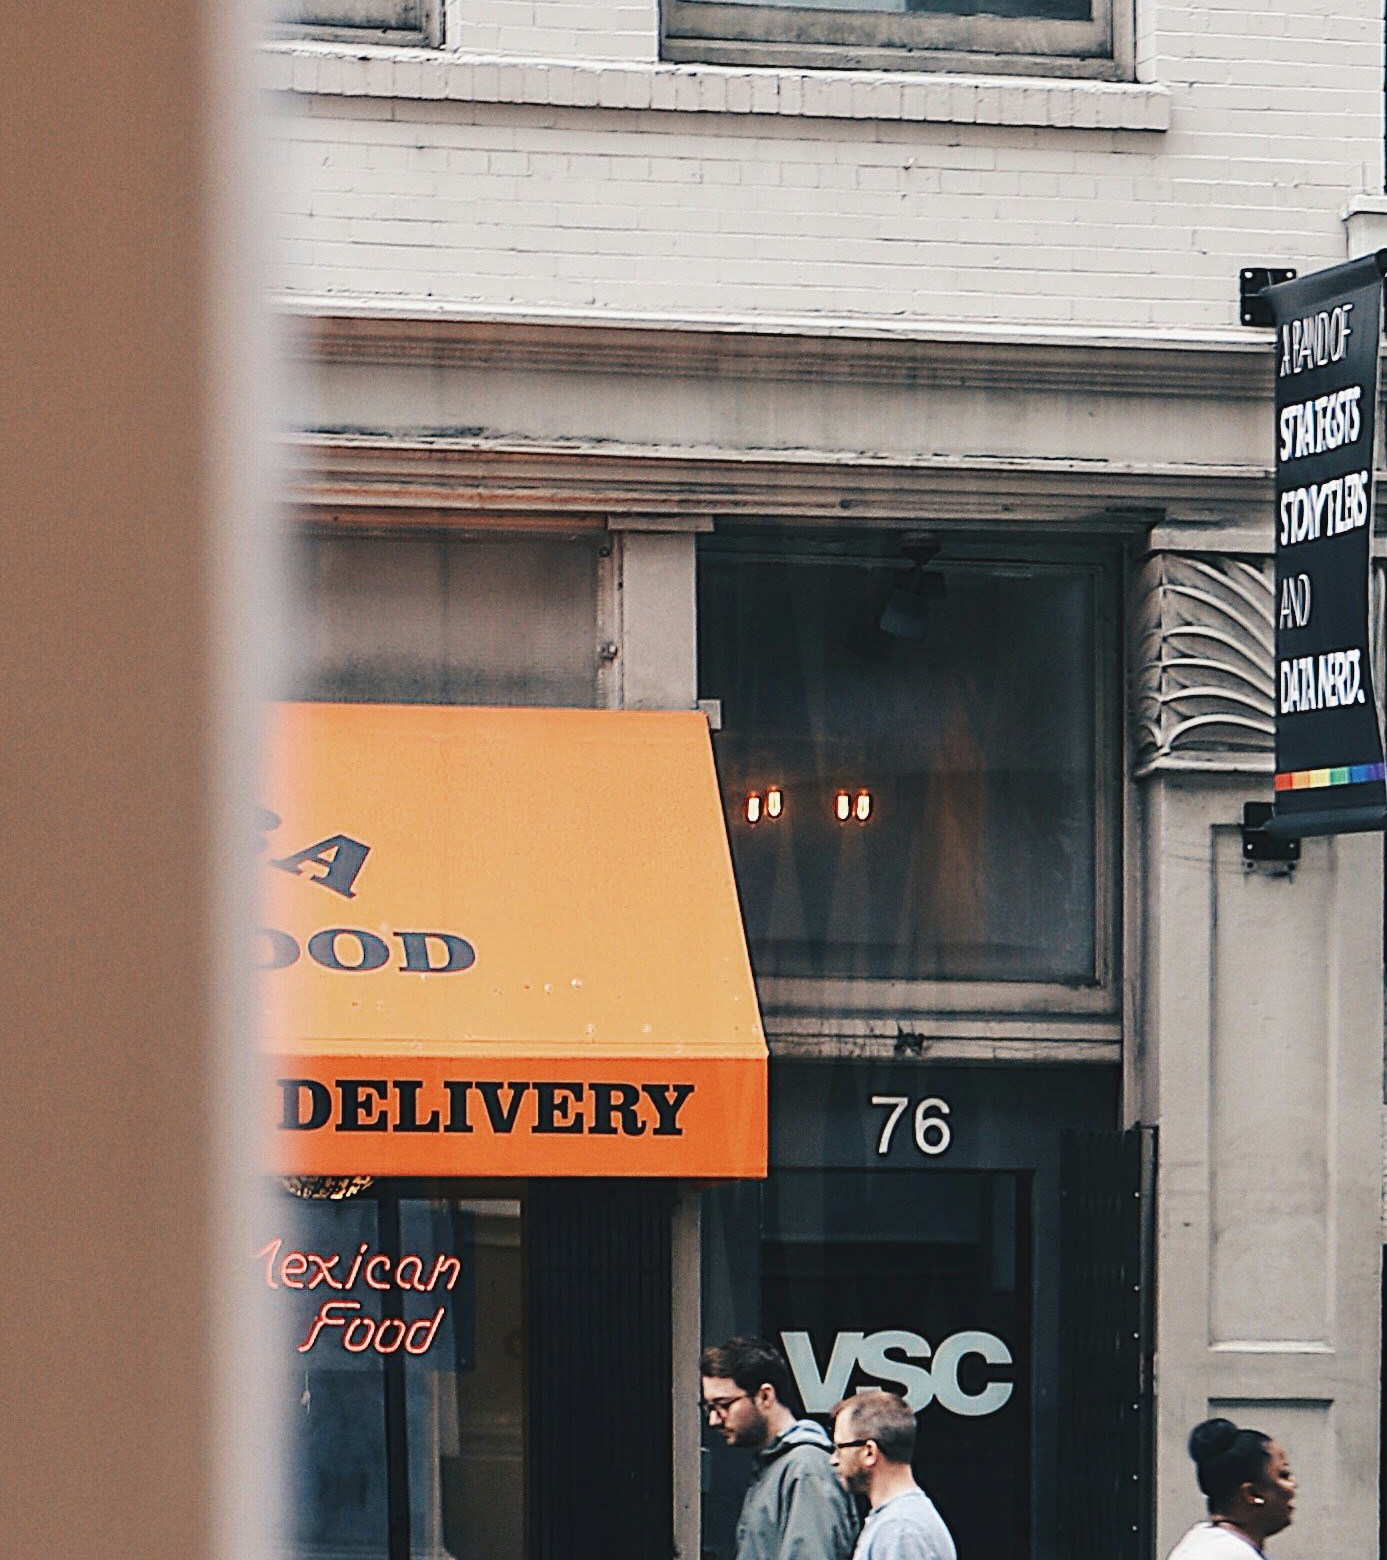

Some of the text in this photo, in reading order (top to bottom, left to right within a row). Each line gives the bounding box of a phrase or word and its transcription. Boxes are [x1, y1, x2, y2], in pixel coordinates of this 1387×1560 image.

[1279, 385, 1362, 462] STRATEGSTS
[1279, 572, 1312, 631] AND
[1280, 655, 1317, 715] DATA
[277, 1078, 695, 1137] DELIVERY
[871, 1095, 952, 1155] 76
[296, 1298, 446, 1355] Food
[779, 1329, 1014, 1417] VSC
